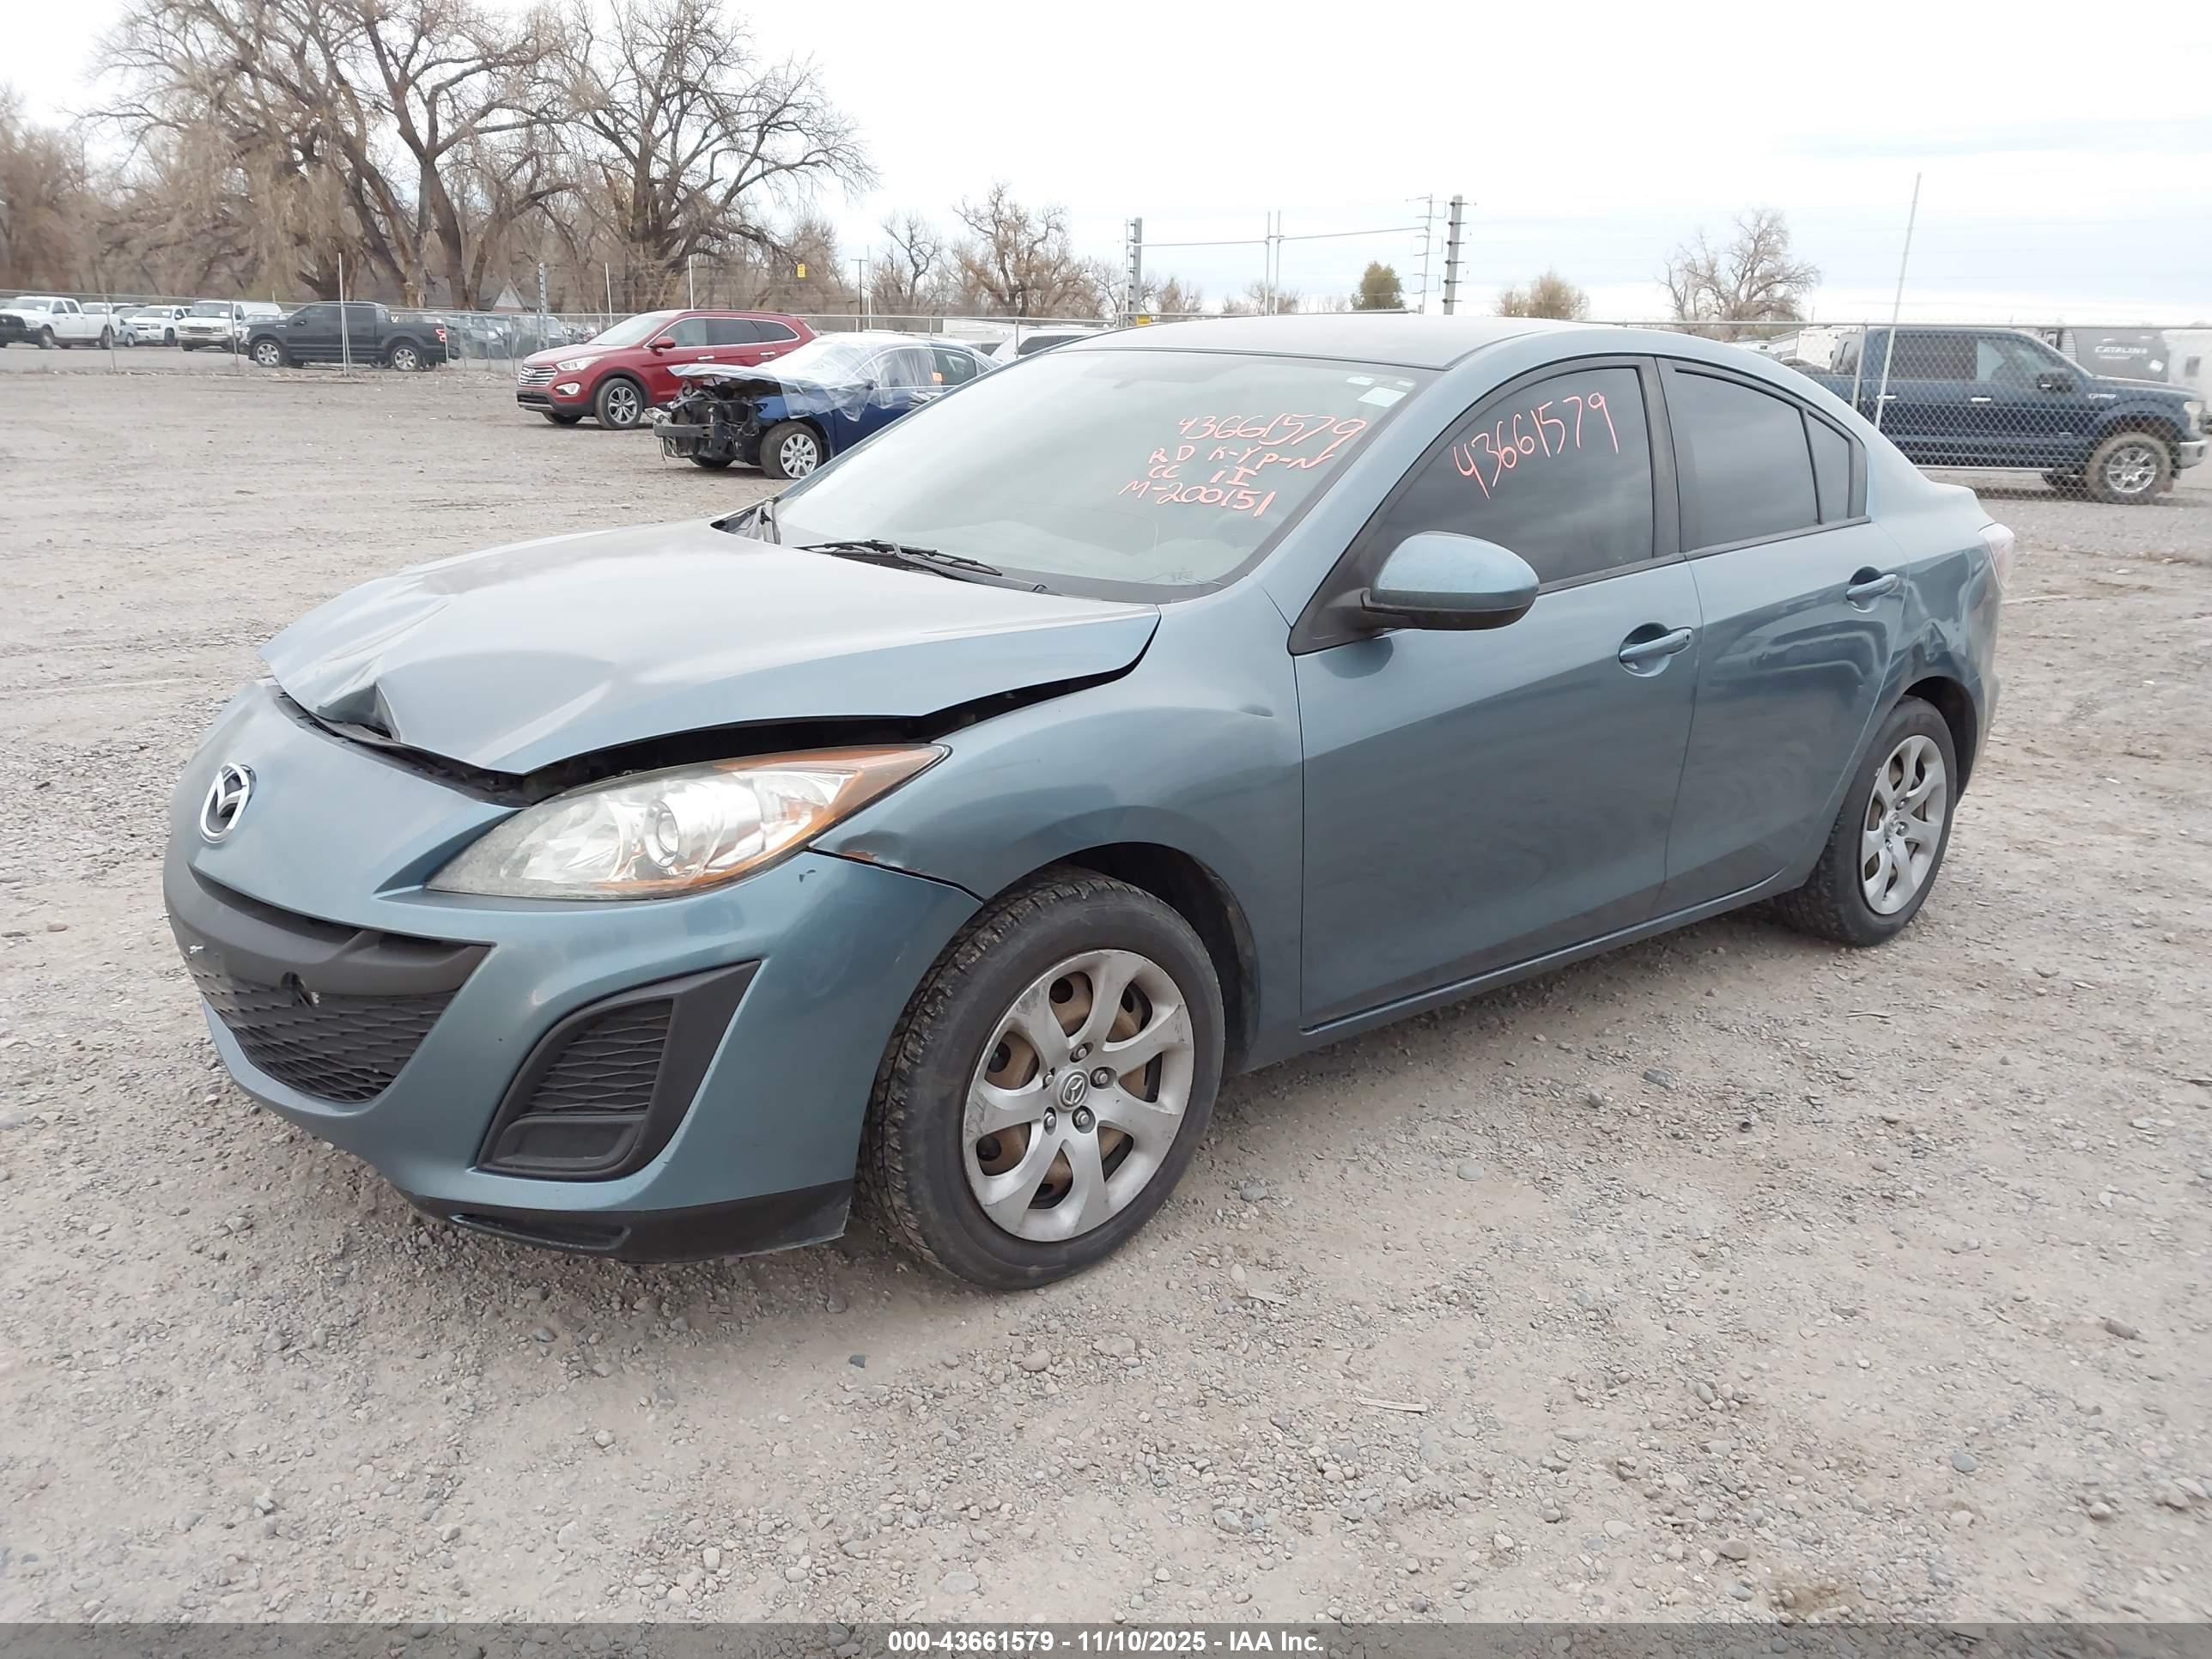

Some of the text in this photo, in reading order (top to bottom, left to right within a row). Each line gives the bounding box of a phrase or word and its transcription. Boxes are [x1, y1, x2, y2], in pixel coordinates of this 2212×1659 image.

[1179, 412, 1367, 454] 43661579
[1452, 391, 1620, 501] 43661579
[1118, 479, 1277, 517] M-200151
